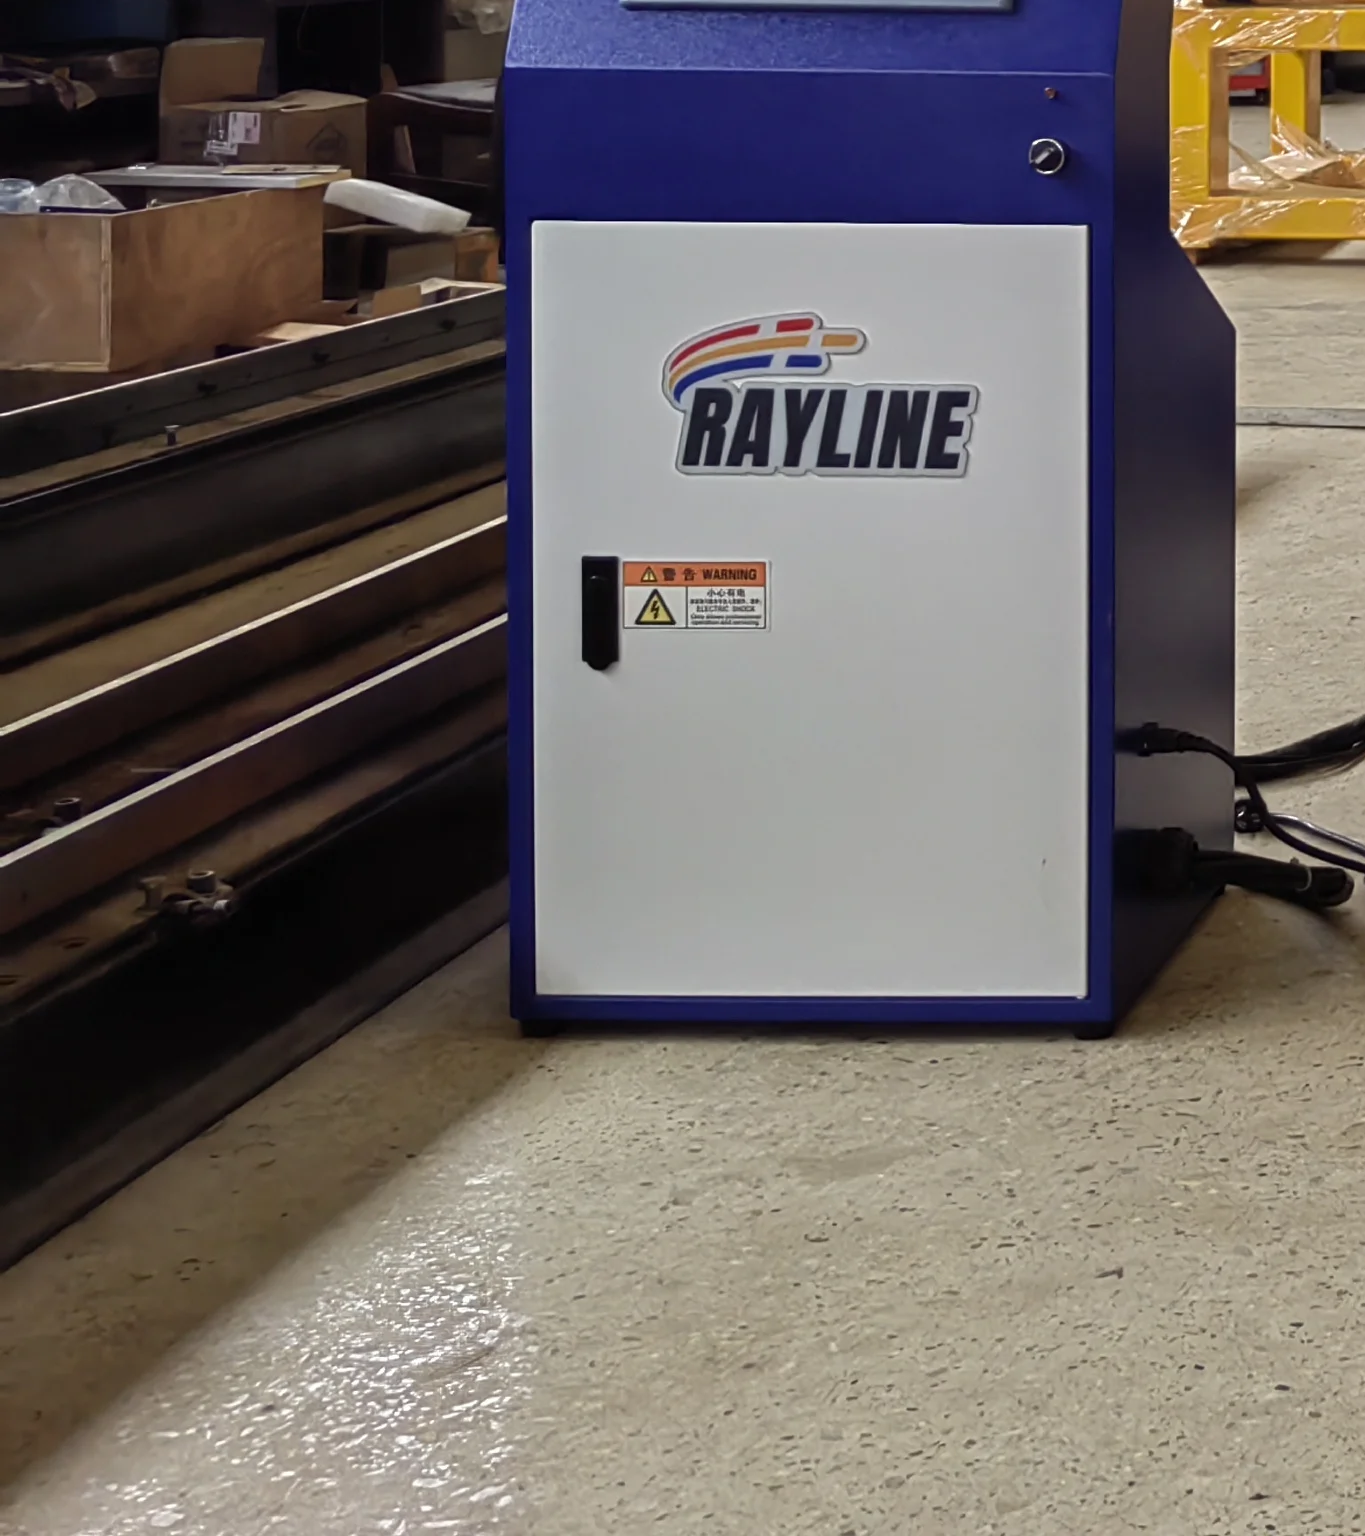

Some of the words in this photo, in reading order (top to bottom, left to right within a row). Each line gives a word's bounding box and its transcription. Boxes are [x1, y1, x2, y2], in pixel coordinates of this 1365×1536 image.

[682, 387, 971, 469] RAYLINE
[702, 568, 757, 581] WARNING
[696, 605, 729, 613] ELECTRIC
